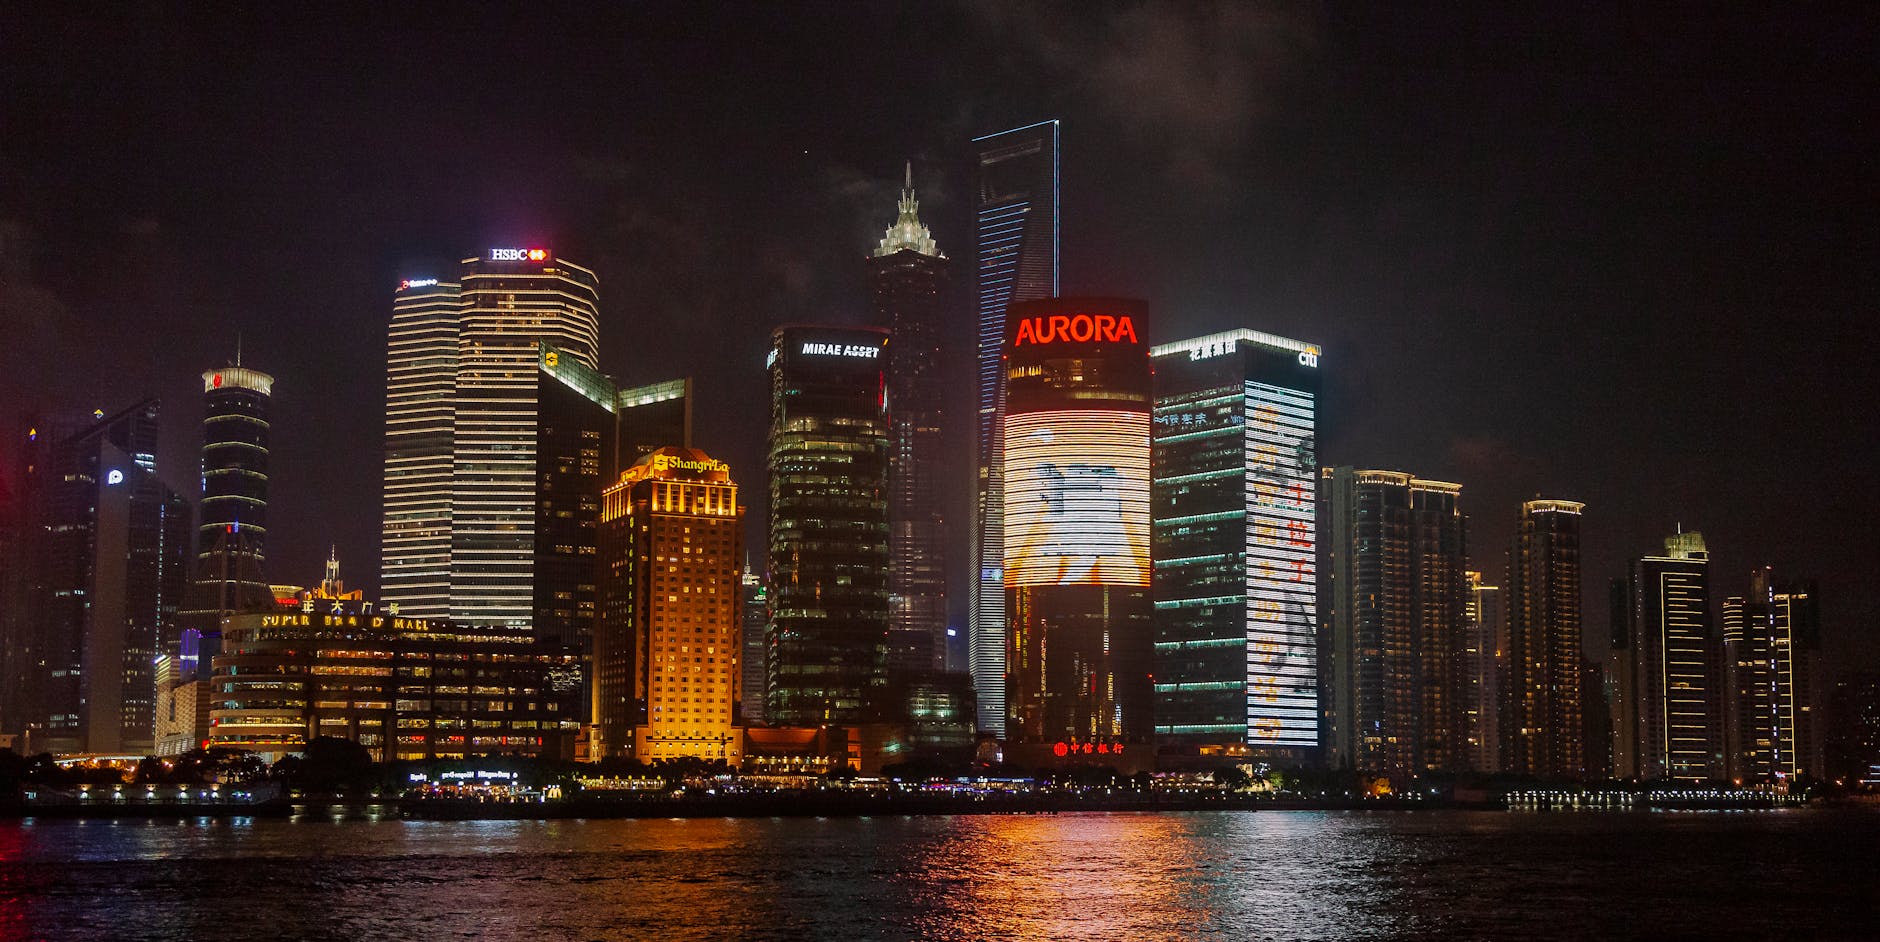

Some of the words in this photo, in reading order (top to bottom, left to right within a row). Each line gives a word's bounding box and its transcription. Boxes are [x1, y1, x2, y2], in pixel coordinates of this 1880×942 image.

[492, 249, 528, 260] HSBC
[1015, 314, 1138, 347] AURORA
[802, 343, 842, 356] MIRAE
[843, 345, 880, 358] ASSET
[1189, 339, 1237, 361] 花旗集团
[1298, 349, 1318, 368] citi
[301, 600, 400, 616] 正大广场
[324, 616, 383, 628] BRAD
[394, 617, 429, 631] MALL
[1070, 742, 1124, 754] 中信银行
